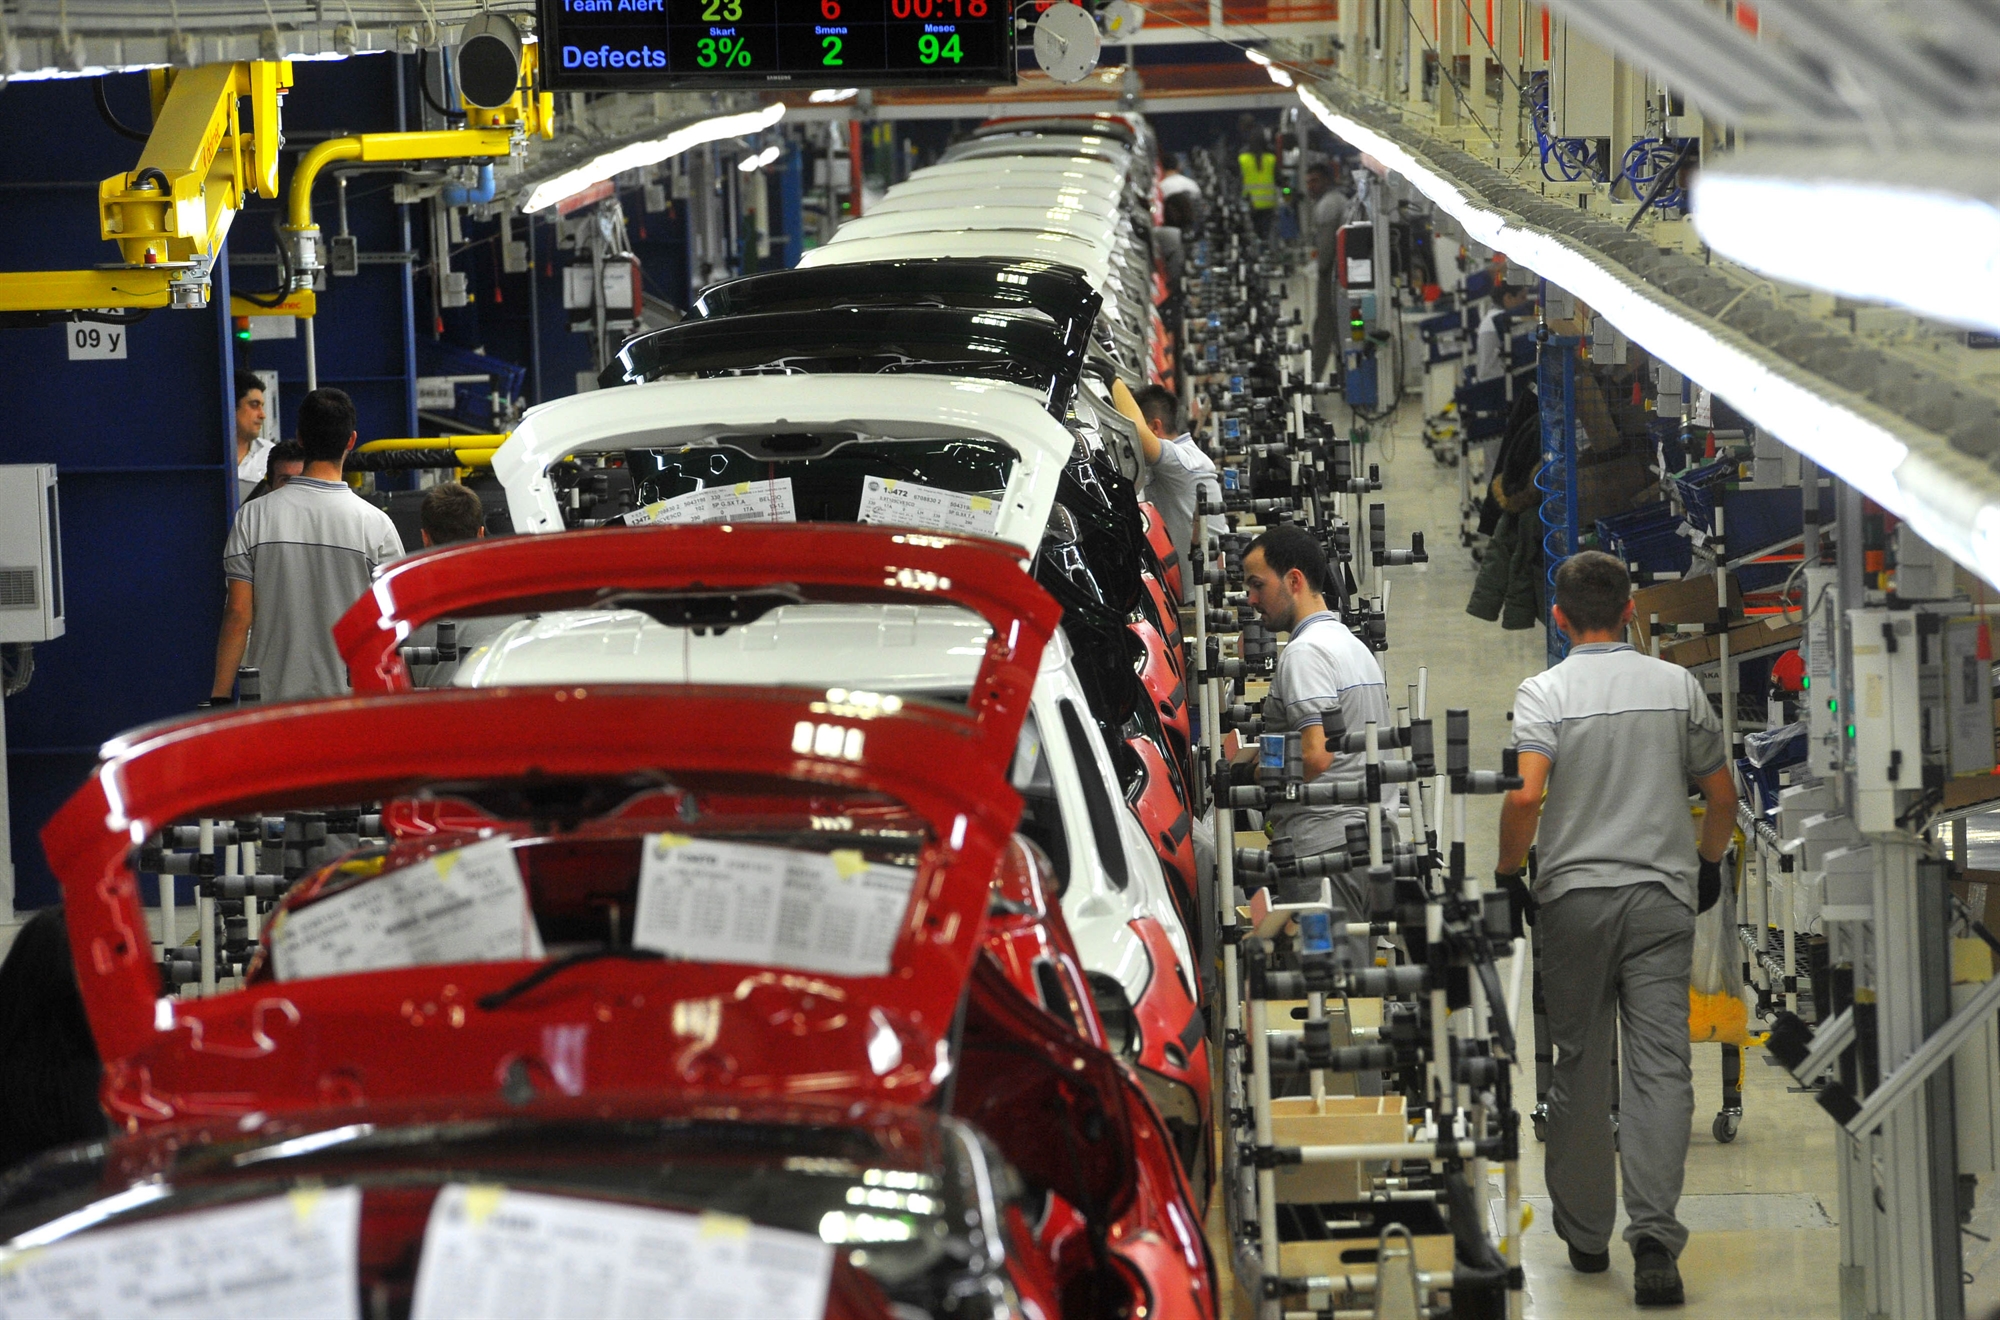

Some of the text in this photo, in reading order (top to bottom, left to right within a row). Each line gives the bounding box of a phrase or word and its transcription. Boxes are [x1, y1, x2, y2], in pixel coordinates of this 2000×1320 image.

[564, 0, 664, 12] Team Alert
[701, 0, 743, 21] 23
[821, 0, 841, 20] 6
[891, 0, 988, 19] 00:18
[709, 26, 736, 36] Skart
[815, 25, 848, 35] Smena
[924, 23, 956, 33] Mesec
[562, 45, 667, 68] Defects
[697, 37, 752, 68] 3%
[822, 35, 843, 66] 2
[918, 33, 964, 65] 94
[75, 328, 121, 353] 09 y
[759, 493, 782, 503] BELO
